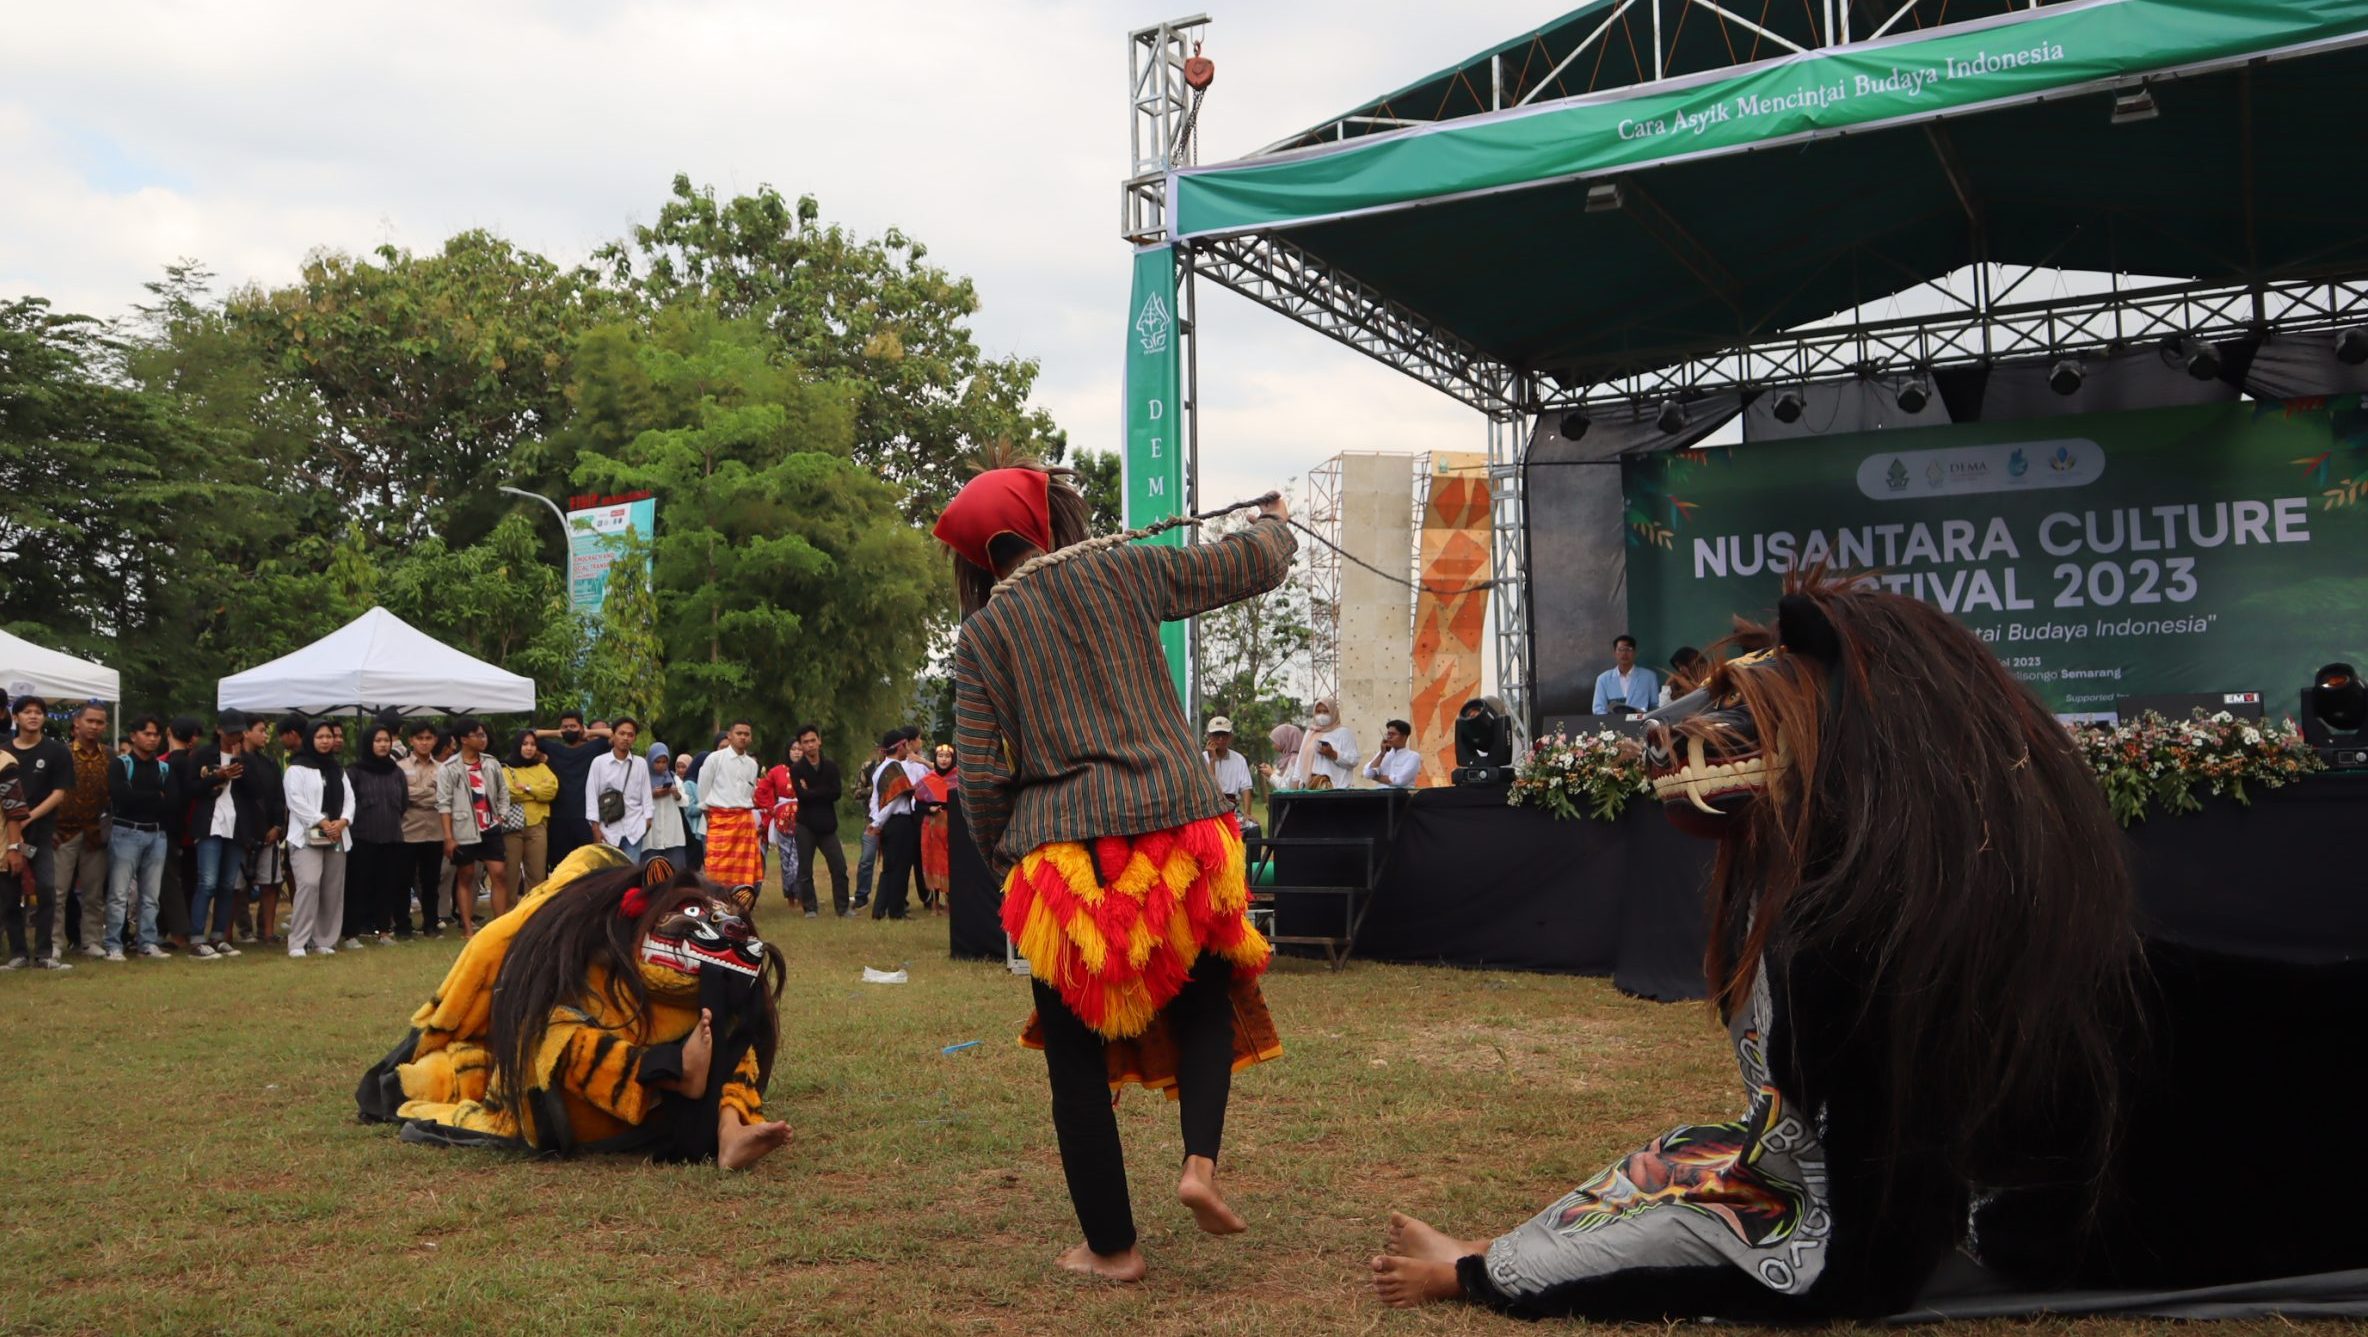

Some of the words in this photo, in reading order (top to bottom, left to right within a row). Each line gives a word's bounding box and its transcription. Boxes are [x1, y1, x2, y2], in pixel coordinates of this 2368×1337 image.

[1618, 117, 1666, 142] Cara
[1671, 104, 1730, 134] Asyik
[1737, 81, 1847, 118] Mencintai
[1854, 67, 1939, 96] Budaya
[1945, 41, 2065, 80] Indonesia
[1693, 517, 2020, 578] NUSANTARA
[2038, 497, 2310, 556] CULTURE
[2053, 557, 2198, 608] 2023
[2008, 622, 2088, 642] Budaya
[2096, 614, 2217, 637] Indonesia"
[2013, 656, 2041, 667] 2023
[2061, 667, 2122, 680] Semarang
[2065, 693, 2114, 704] Supported
